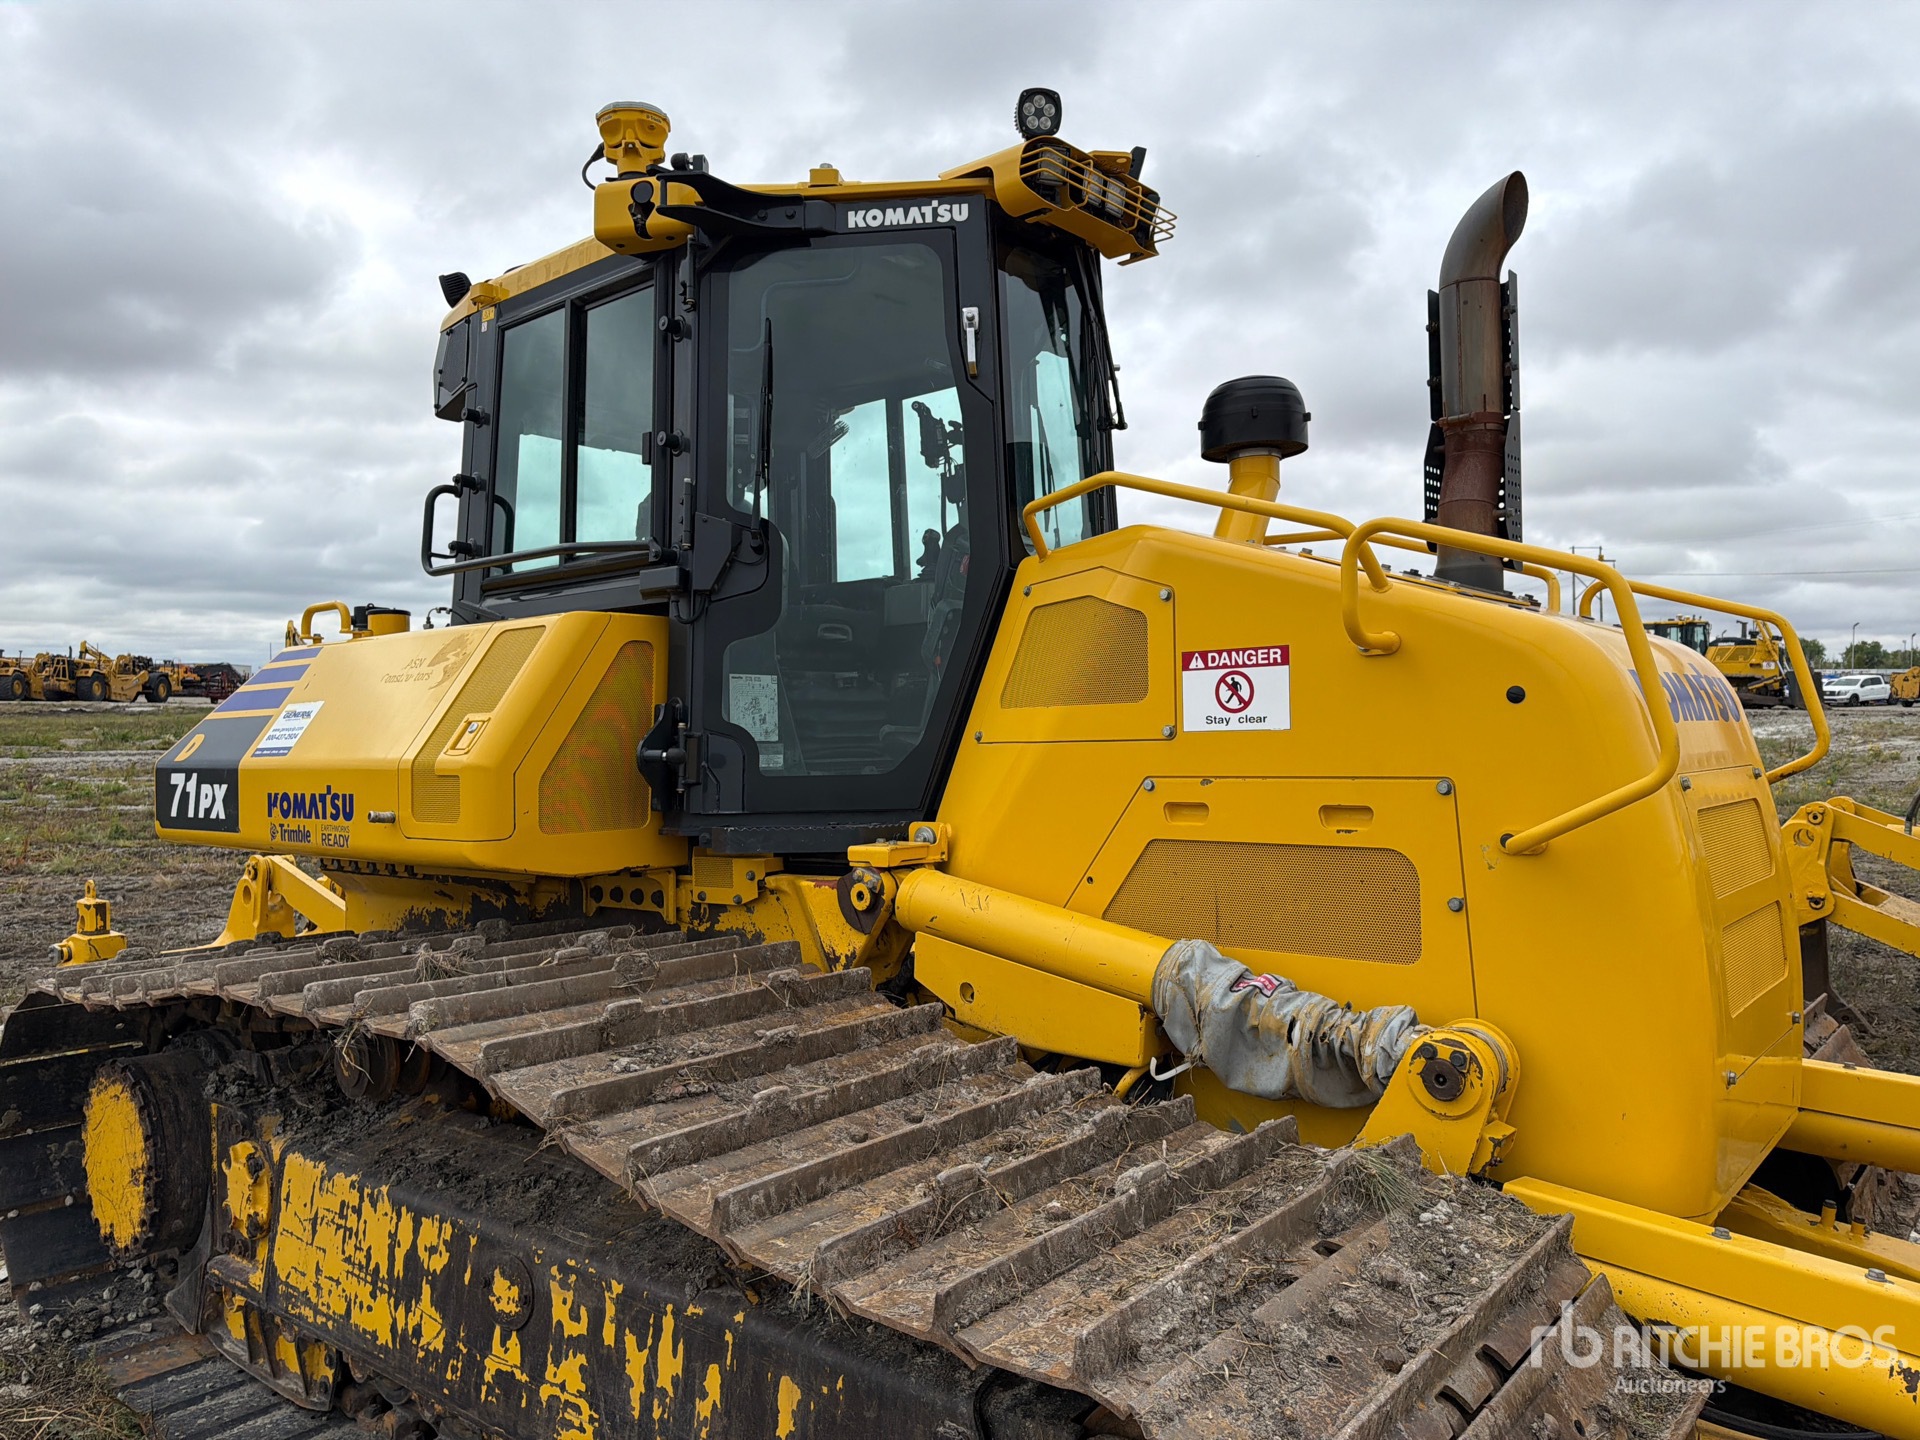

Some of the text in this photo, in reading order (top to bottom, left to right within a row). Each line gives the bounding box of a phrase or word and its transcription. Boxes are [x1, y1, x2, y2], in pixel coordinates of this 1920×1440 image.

[847, 200, 969, 229] KOMATSU
[1207, 648, 1282, 667] DANGER
[380, 669, 434, 684] Constutors
[1627, 662, 1741, 724] OMATSU
[283, 710, 313, 719] GENERAL
[1205, 714, 1268, 726] Stay clear
[173, 733, 205, 762] D
[170, 772, 228, 819] 71PX
[267, 784, 355, 822] KOMATSU
[279, 823, 312, 844] Trimble
[320, 824, 350, 834] EARTHWORKS
[321, 832, 350, 849] READY
